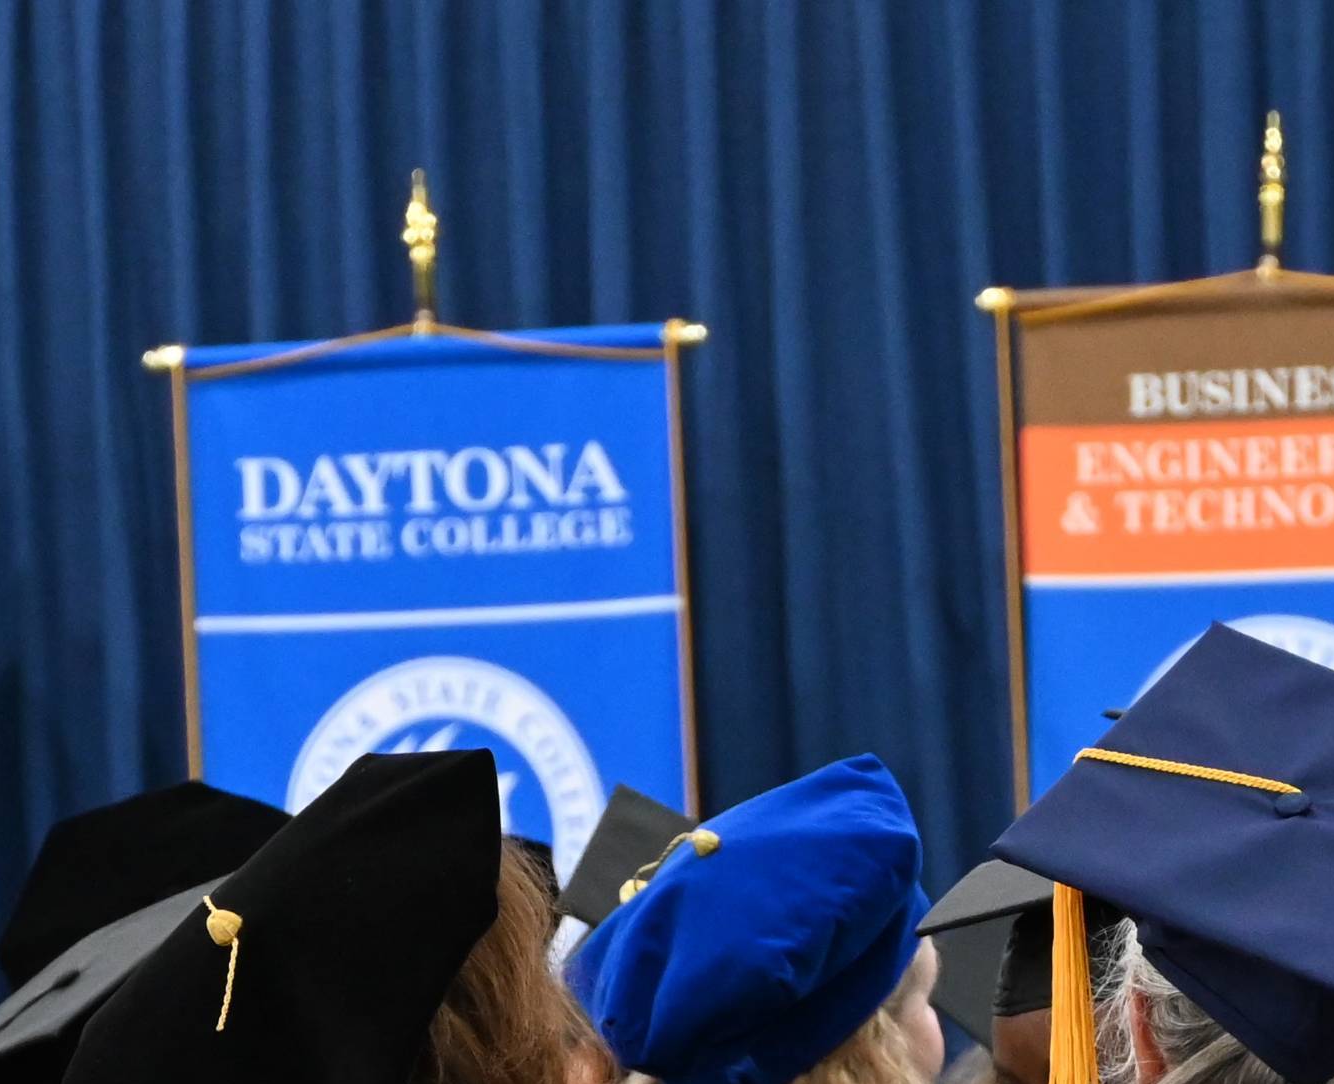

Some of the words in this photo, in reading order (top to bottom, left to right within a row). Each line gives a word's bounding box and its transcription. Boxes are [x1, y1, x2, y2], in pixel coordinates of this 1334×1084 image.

[237, 441, 628, 521] DAYTONA
[240, 520, 392, 563] STATE
[400, 507, 633, 557] COLLEGE
[1060, 491, 1101, 535] &
